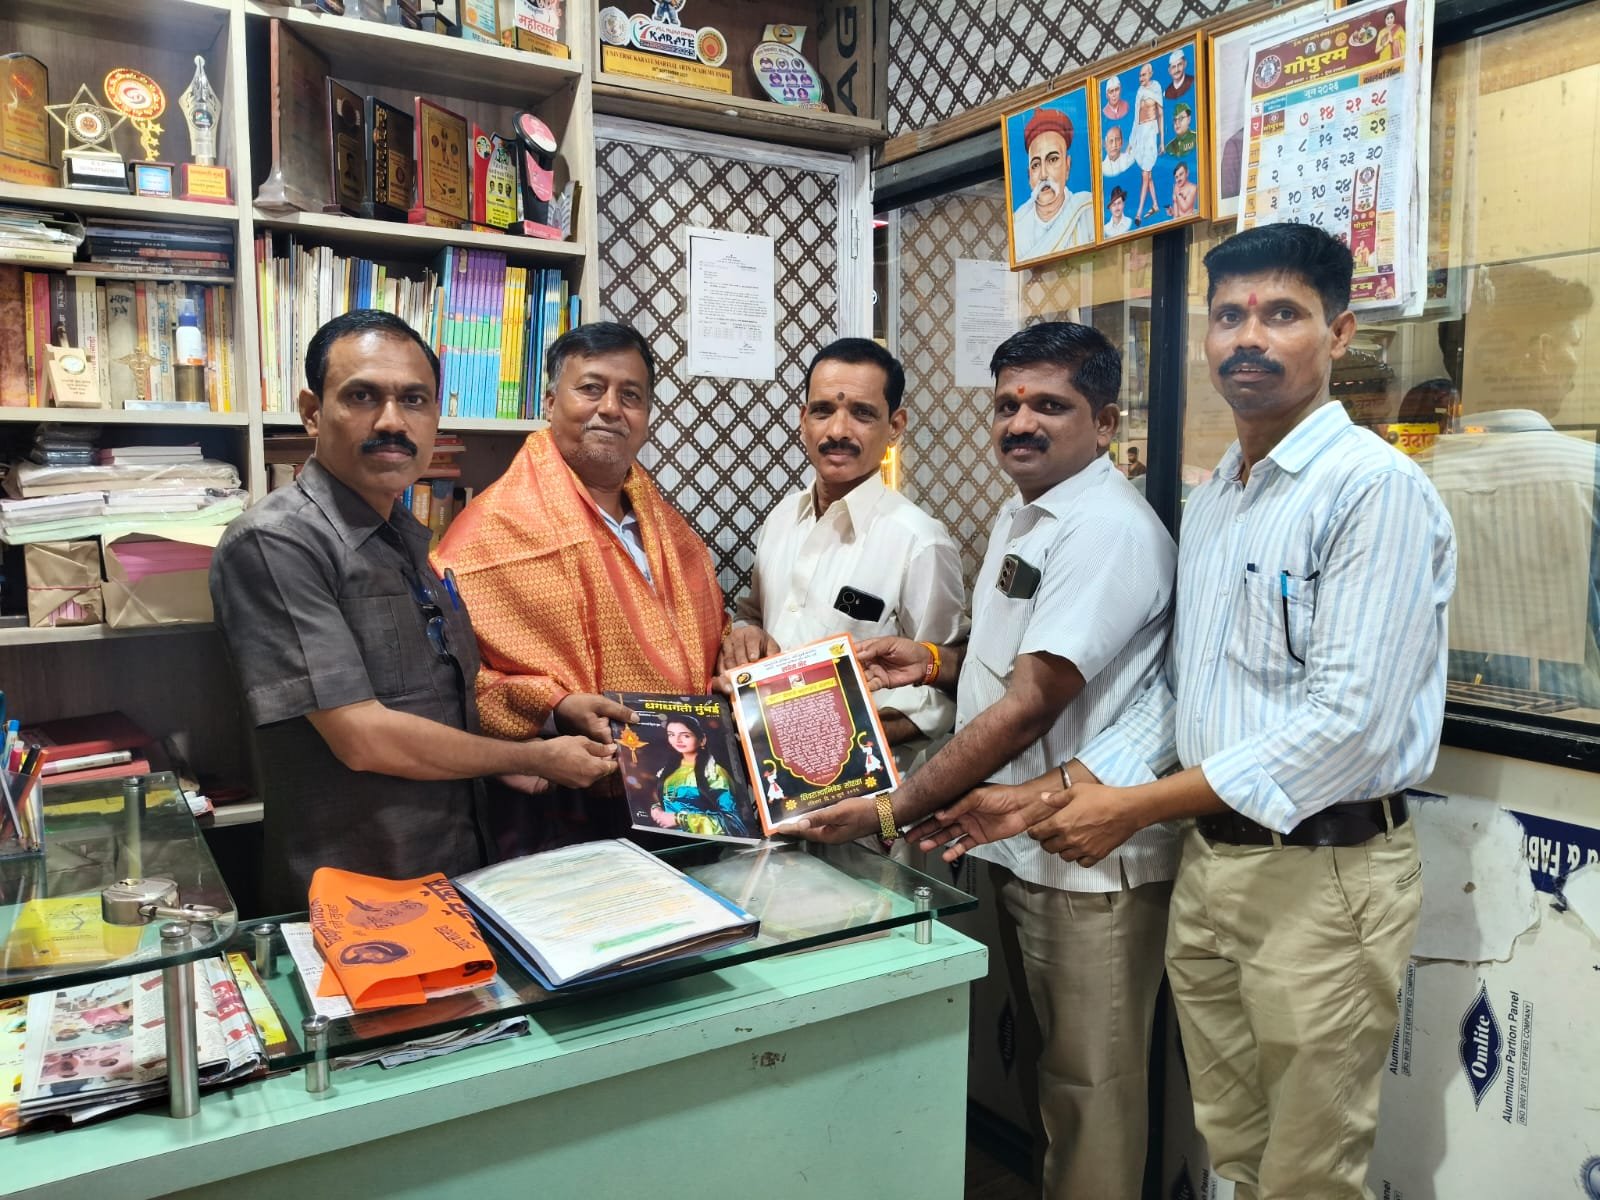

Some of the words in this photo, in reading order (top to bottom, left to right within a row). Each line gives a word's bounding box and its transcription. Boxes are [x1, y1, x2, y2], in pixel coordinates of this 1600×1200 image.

[649, 30, 695, 49] KARATE
[1283, 46, 1349, 75] गोपुरम
[695, 702, 720, 716] मुंबई
[1507, 990, 1519, 1022] Panel
[1523, 1003, 1532, 1039] COMPANY
[1471, 1014, 1490, 1079] Omlite
[1505, 1024, 1517, 1063] Partion
[1521, 1039, 1530, 1076] CERTIFIED
[1502, 1066, 1515, 1124] Aluminium
